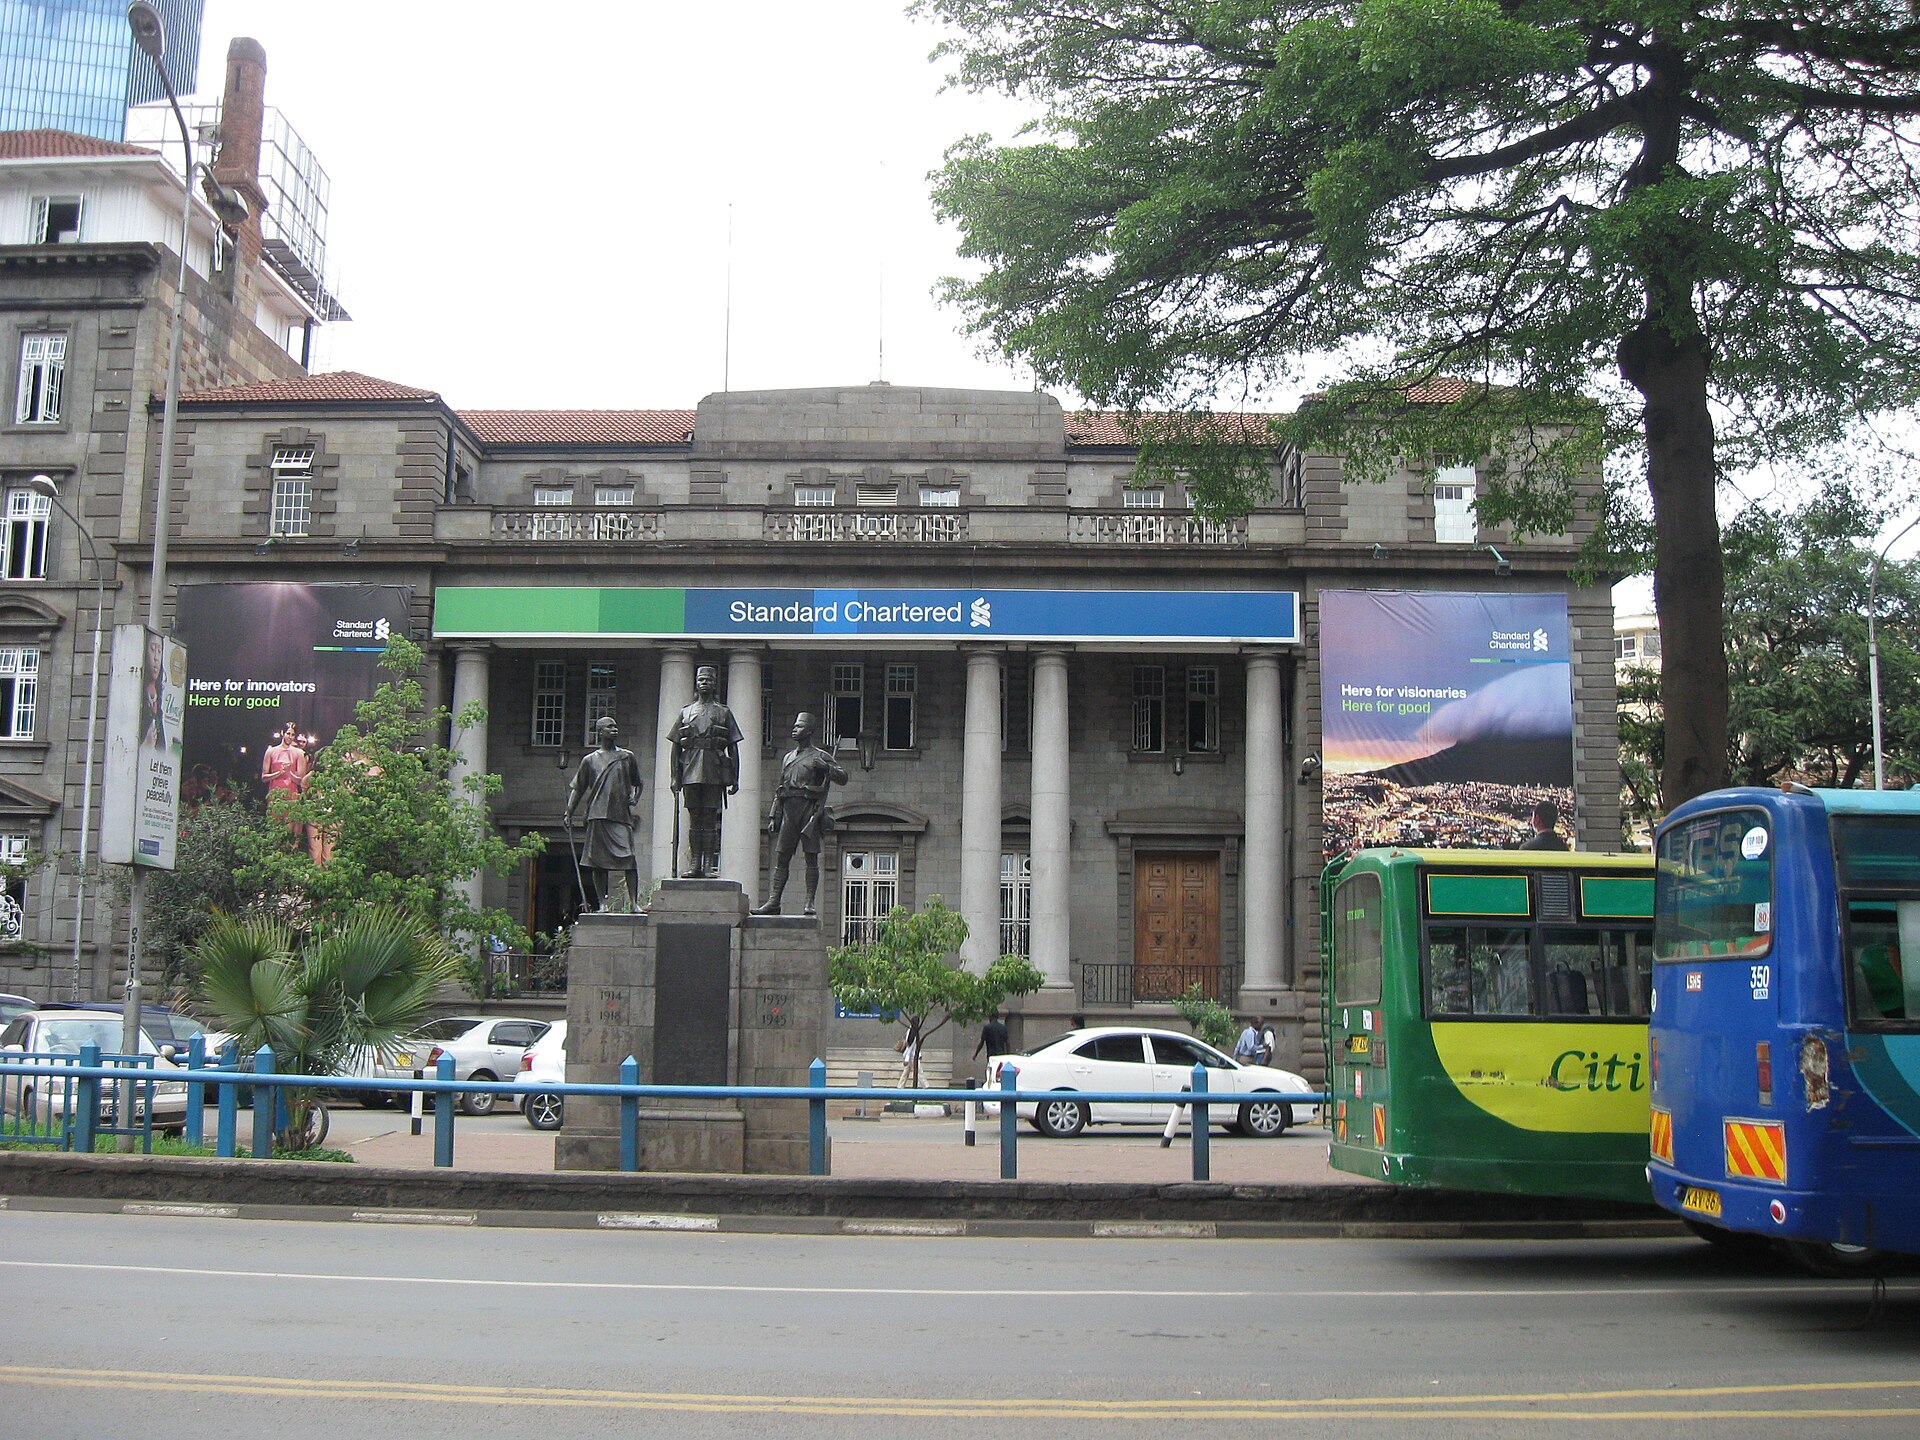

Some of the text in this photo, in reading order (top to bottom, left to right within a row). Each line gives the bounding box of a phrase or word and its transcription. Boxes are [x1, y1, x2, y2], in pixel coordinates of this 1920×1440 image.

[729, 601, 962, 623] Standard Chartered
[336, 620, 373, 629] Standard
[333, 629, 372, 638] Chartered
[1492, 631, 1530, 640] Standard
[1489, 641, 1530, 649] Chartered
[189, 679, 316, 692] Here for innovators
[1341, 685, 1467, 698] Here for visionaries
[189, 695, 220, 707] Here
[224, 695, 242, 706] for
[246, 695, 280, 709] good
[1342, 700, 1431, 715] Here for good
[150, 759, 172, 777] Let them
[152, 775, 169, 790] grieve
[146, 789, 172, 808] peacefully
[1758, 912, 1767, 923] 80
[1750, 965, 1770, 988] 350
[600, 990, 623, 1001] 1914
[764, 994, 787, 1006] 1939
[600, 1010, 621, 1021] 1918
[762, 1014, 787, 1026] 1945
[1551, 1050, 1645, 1092] Citi
